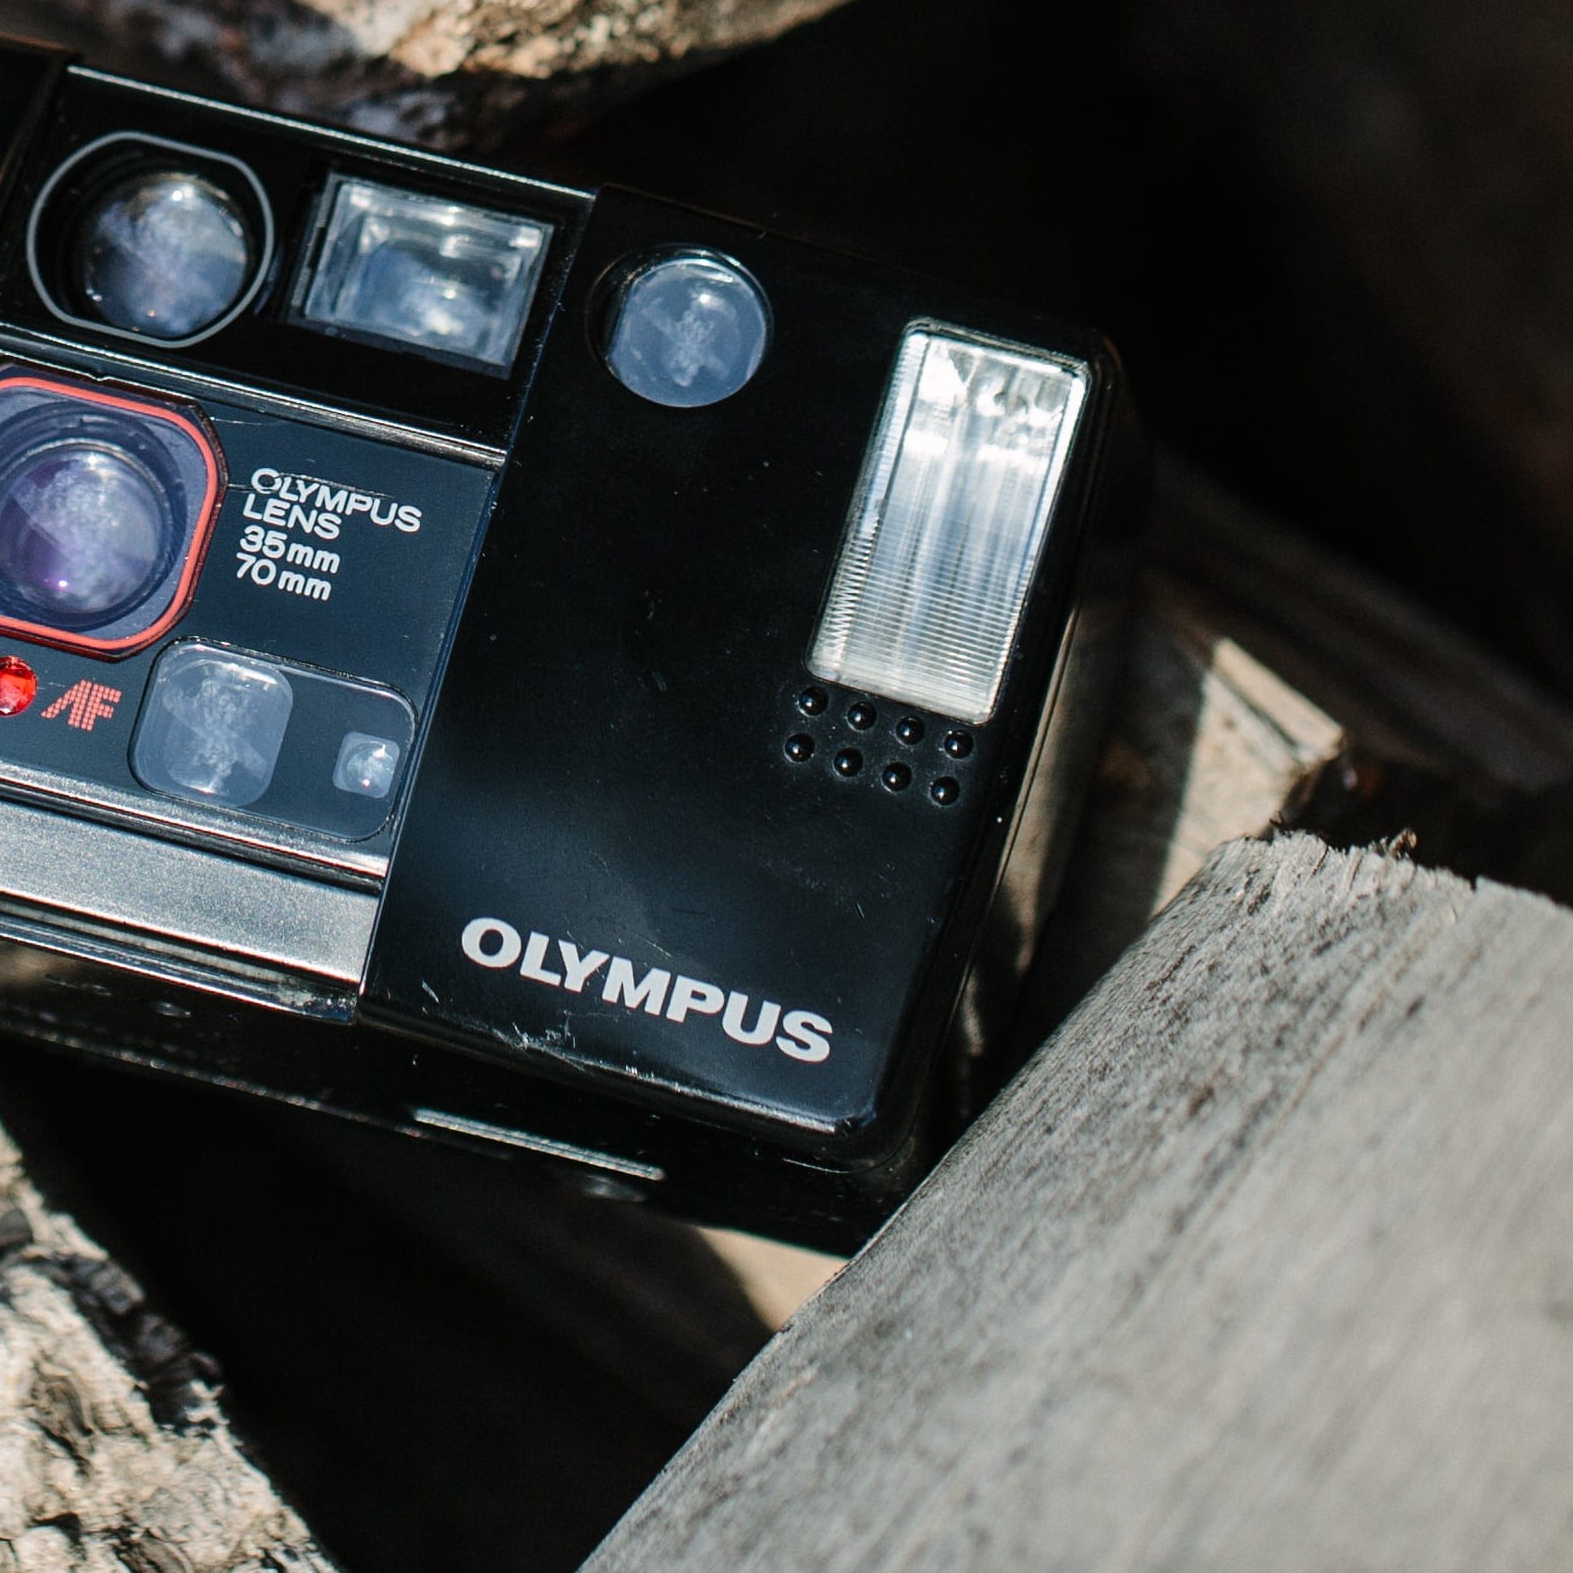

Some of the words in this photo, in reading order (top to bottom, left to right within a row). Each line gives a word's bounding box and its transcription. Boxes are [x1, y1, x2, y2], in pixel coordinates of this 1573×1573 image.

[243, 493, 342, 539] LENS
[251, 468, 423, 532] OLYMPUS
[40, 679, 123, 732] AF
[461, 917, 833, 1063] OLYMPUS
